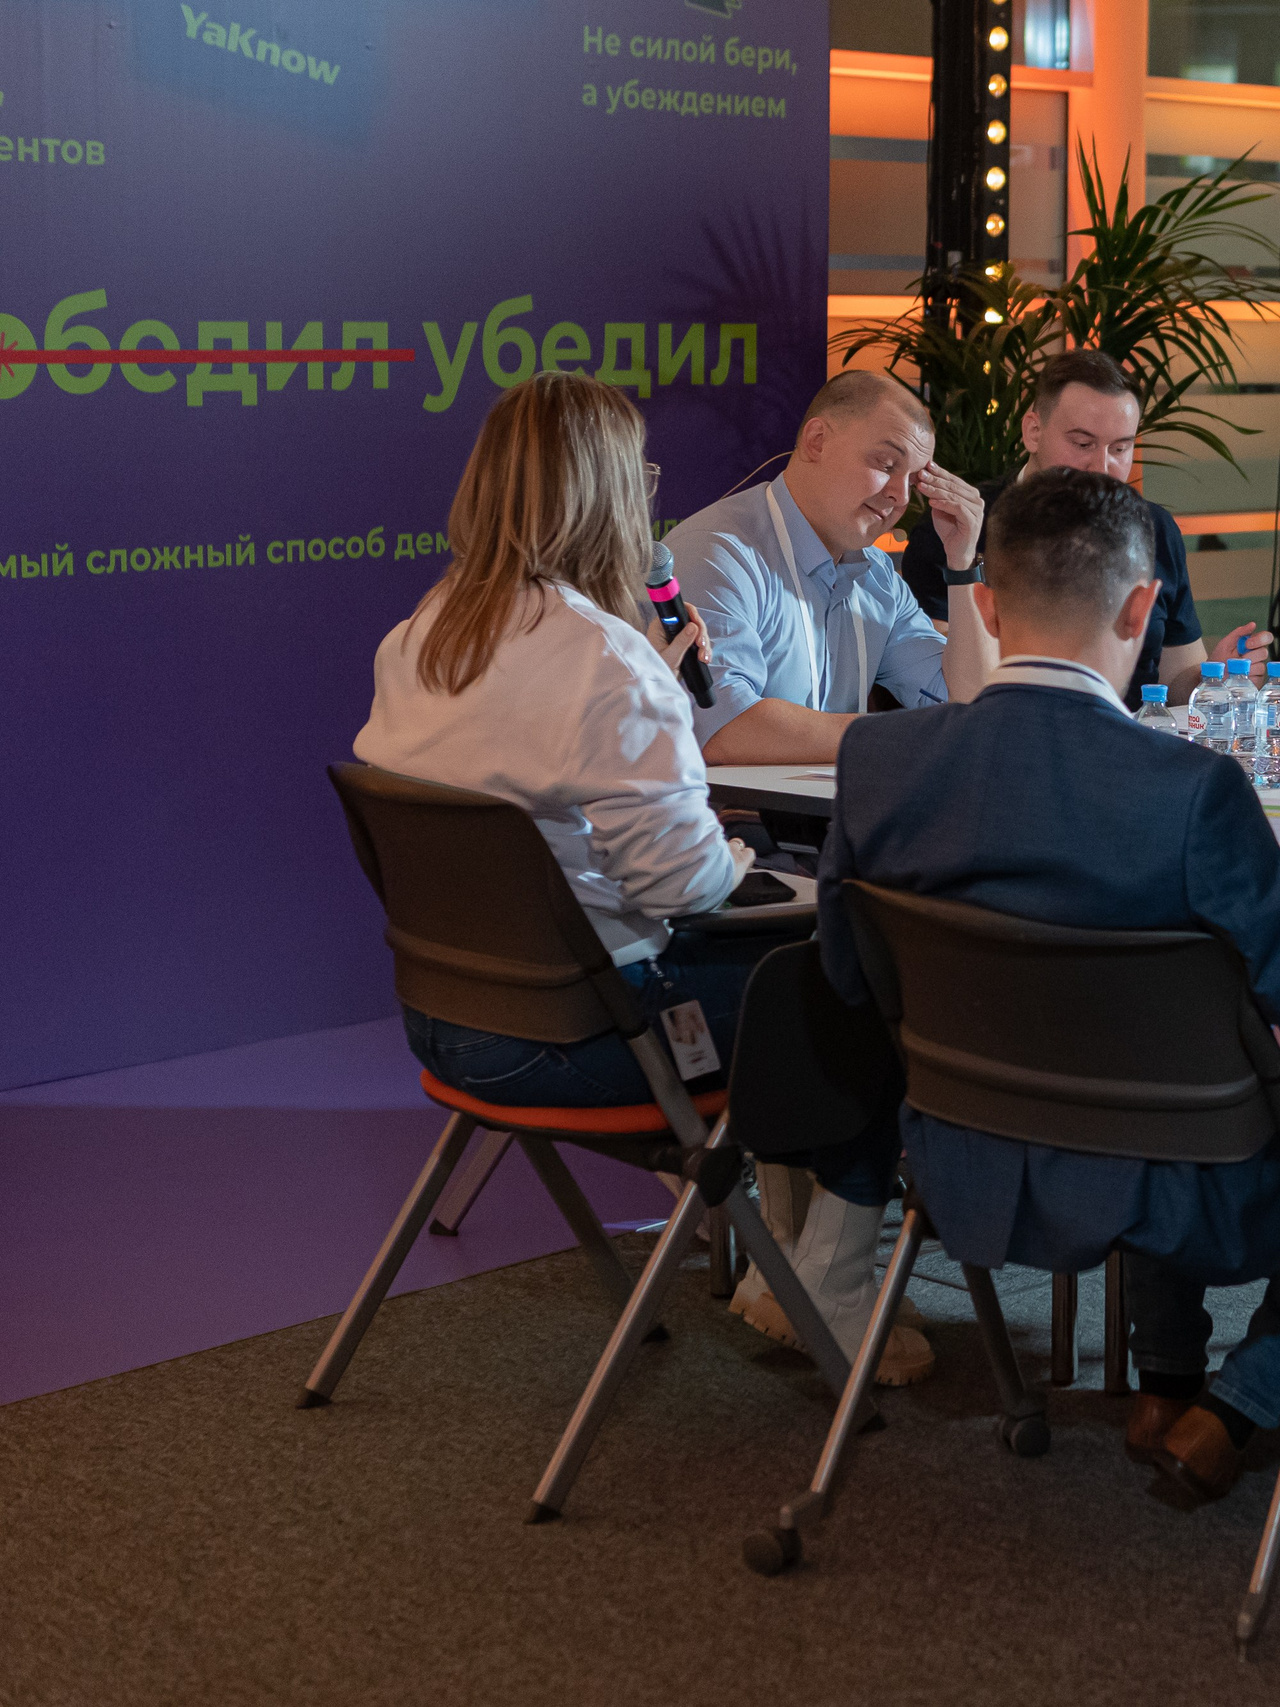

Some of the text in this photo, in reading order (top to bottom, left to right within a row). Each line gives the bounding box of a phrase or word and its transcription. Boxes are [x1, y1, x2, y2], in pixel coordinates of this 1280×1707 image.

[181, 3, 341, 85] YaKnow
[583, 25, 797, 75] Не силой бери,
[582, 78, 787, 118] а убеждением
[422, 294, 757, 413] убедил
[86, 534, 256, 575] сложный
[266, 526, 386, 564] способ
